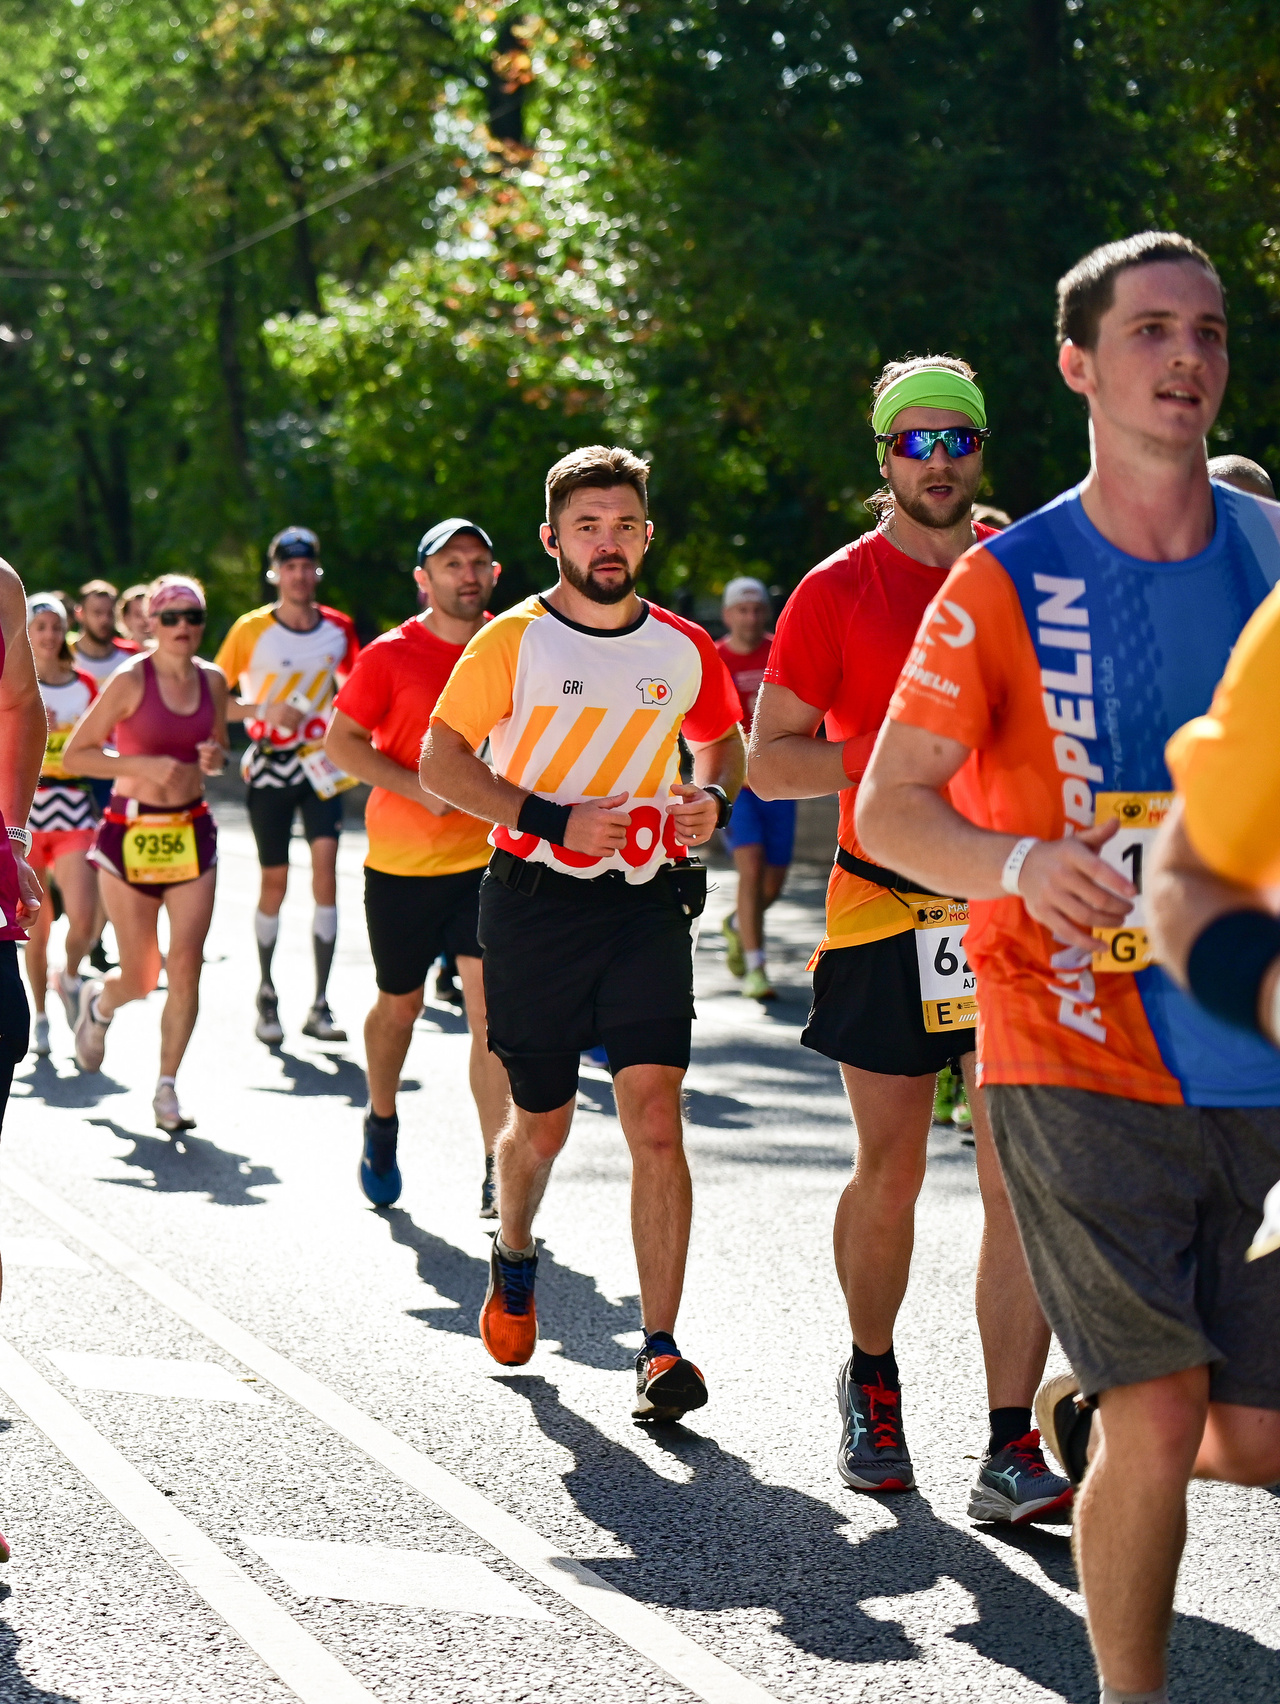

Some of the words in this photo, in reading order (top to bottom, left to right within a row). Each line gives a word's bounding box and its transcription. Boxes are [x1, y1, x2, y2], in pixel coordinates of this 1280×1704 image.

[562, 680, 584, 695] GRi
[134, 833, 185, 855] 9356
[1111, 932, 1137, 963] G
[937, 1002, 953, 1025] E
